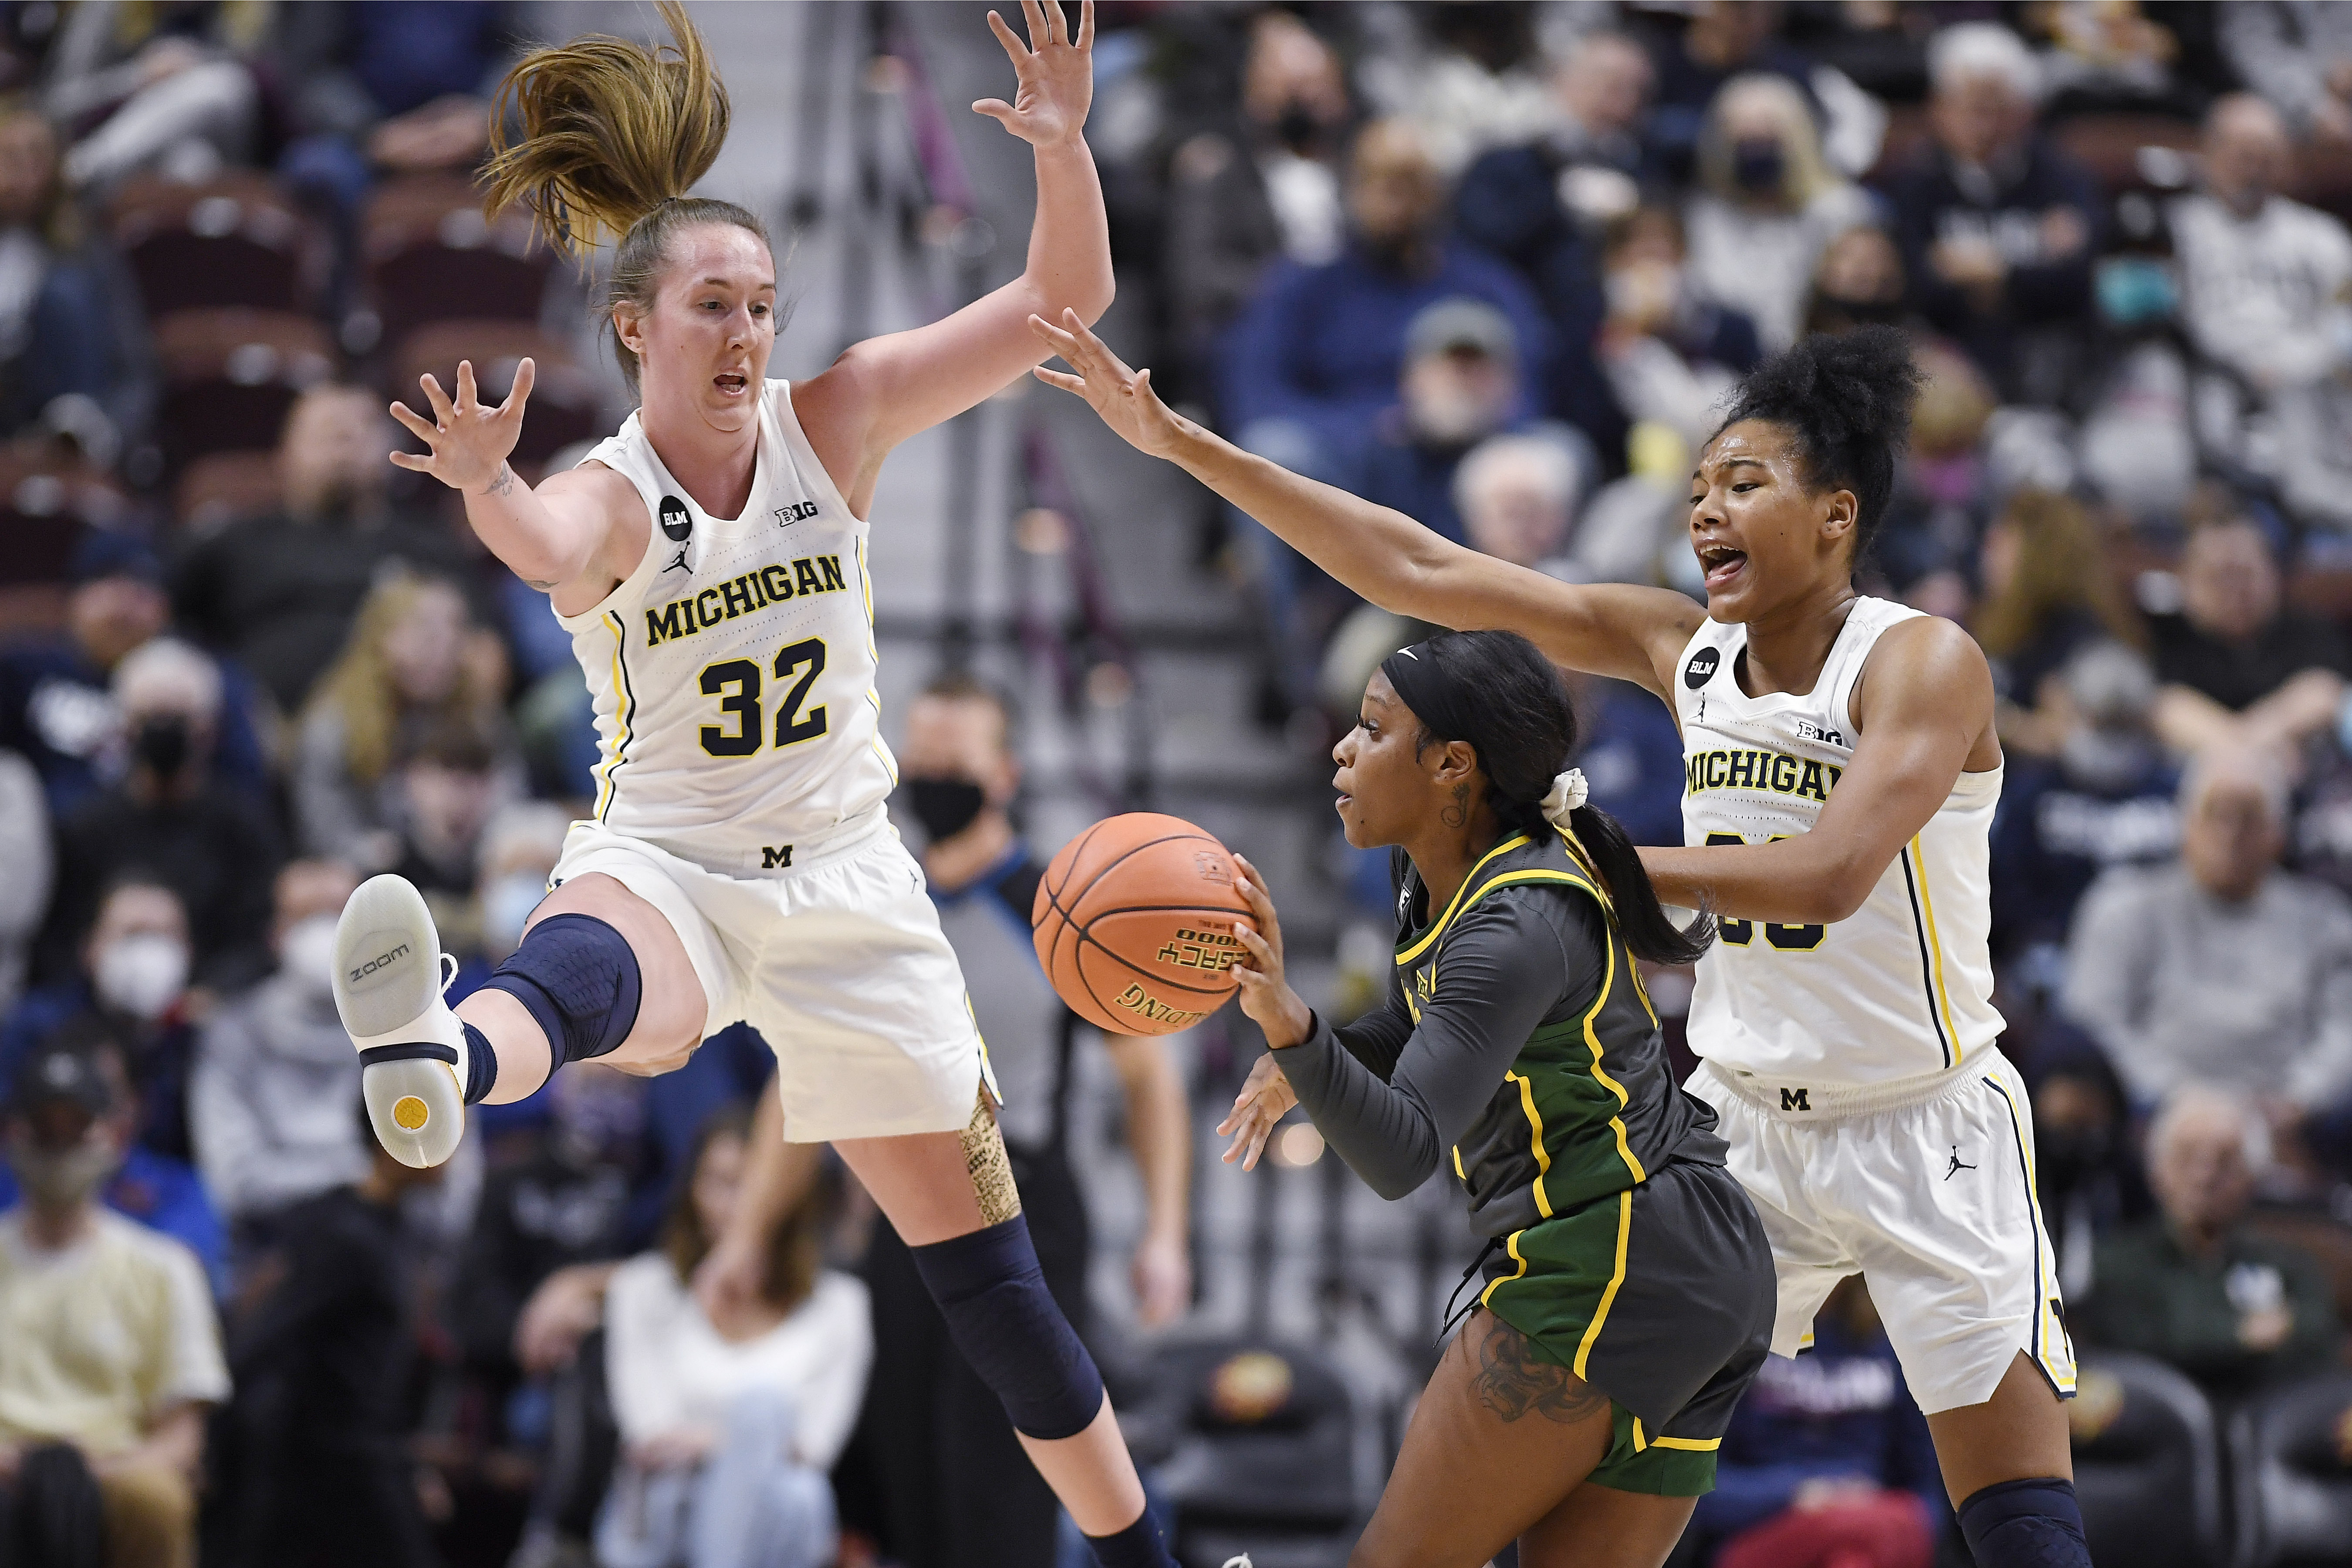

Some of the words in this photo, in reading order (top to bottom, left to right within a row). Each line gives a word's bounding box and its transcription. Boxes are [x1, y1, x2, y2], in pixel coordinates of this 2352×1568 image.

[662, 510, 688, 526] BLM
[645, 554, 847, 647] MICHIGAN
[1688, 660, 1715, 675] BLM
[697, 635, 829, 758] 32
[761, 844, 793, 869] M
[1780, 1087, 1811, 1111] M
